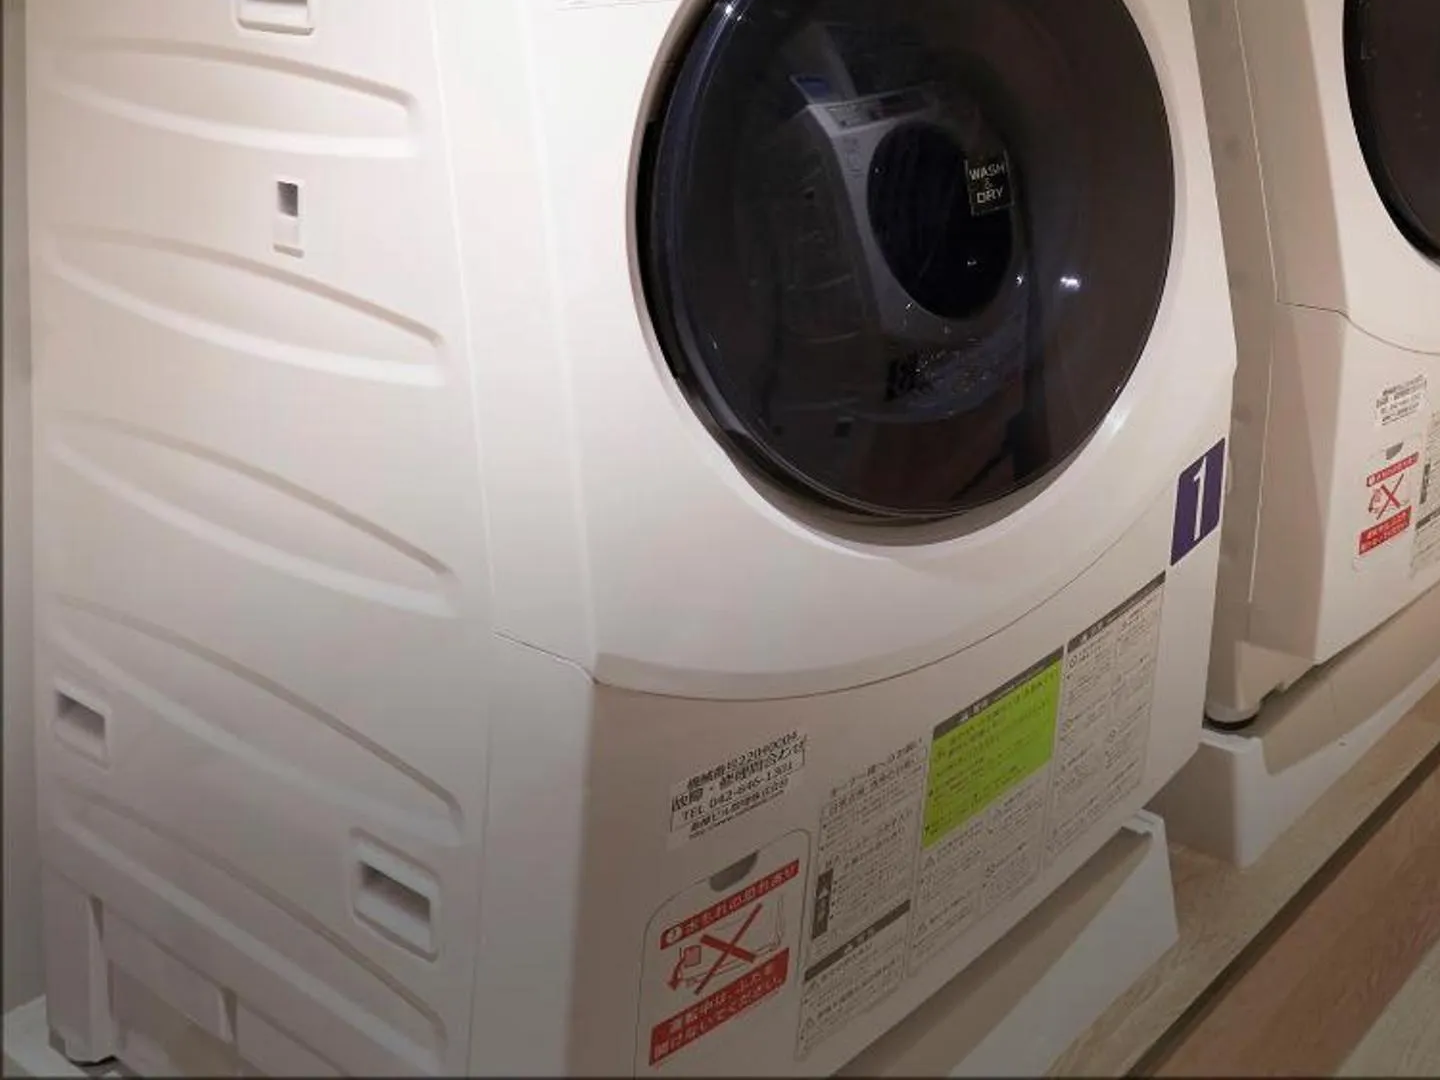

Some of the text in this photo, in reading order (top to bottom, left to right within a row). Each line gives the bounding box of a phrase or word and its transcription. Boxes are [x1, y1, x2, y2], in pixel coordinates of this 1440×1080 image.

[969, 164, 1006, 180] WASH
[976, 187, 1004, 203] DRY
[682, 805, 704, 821] TEL
